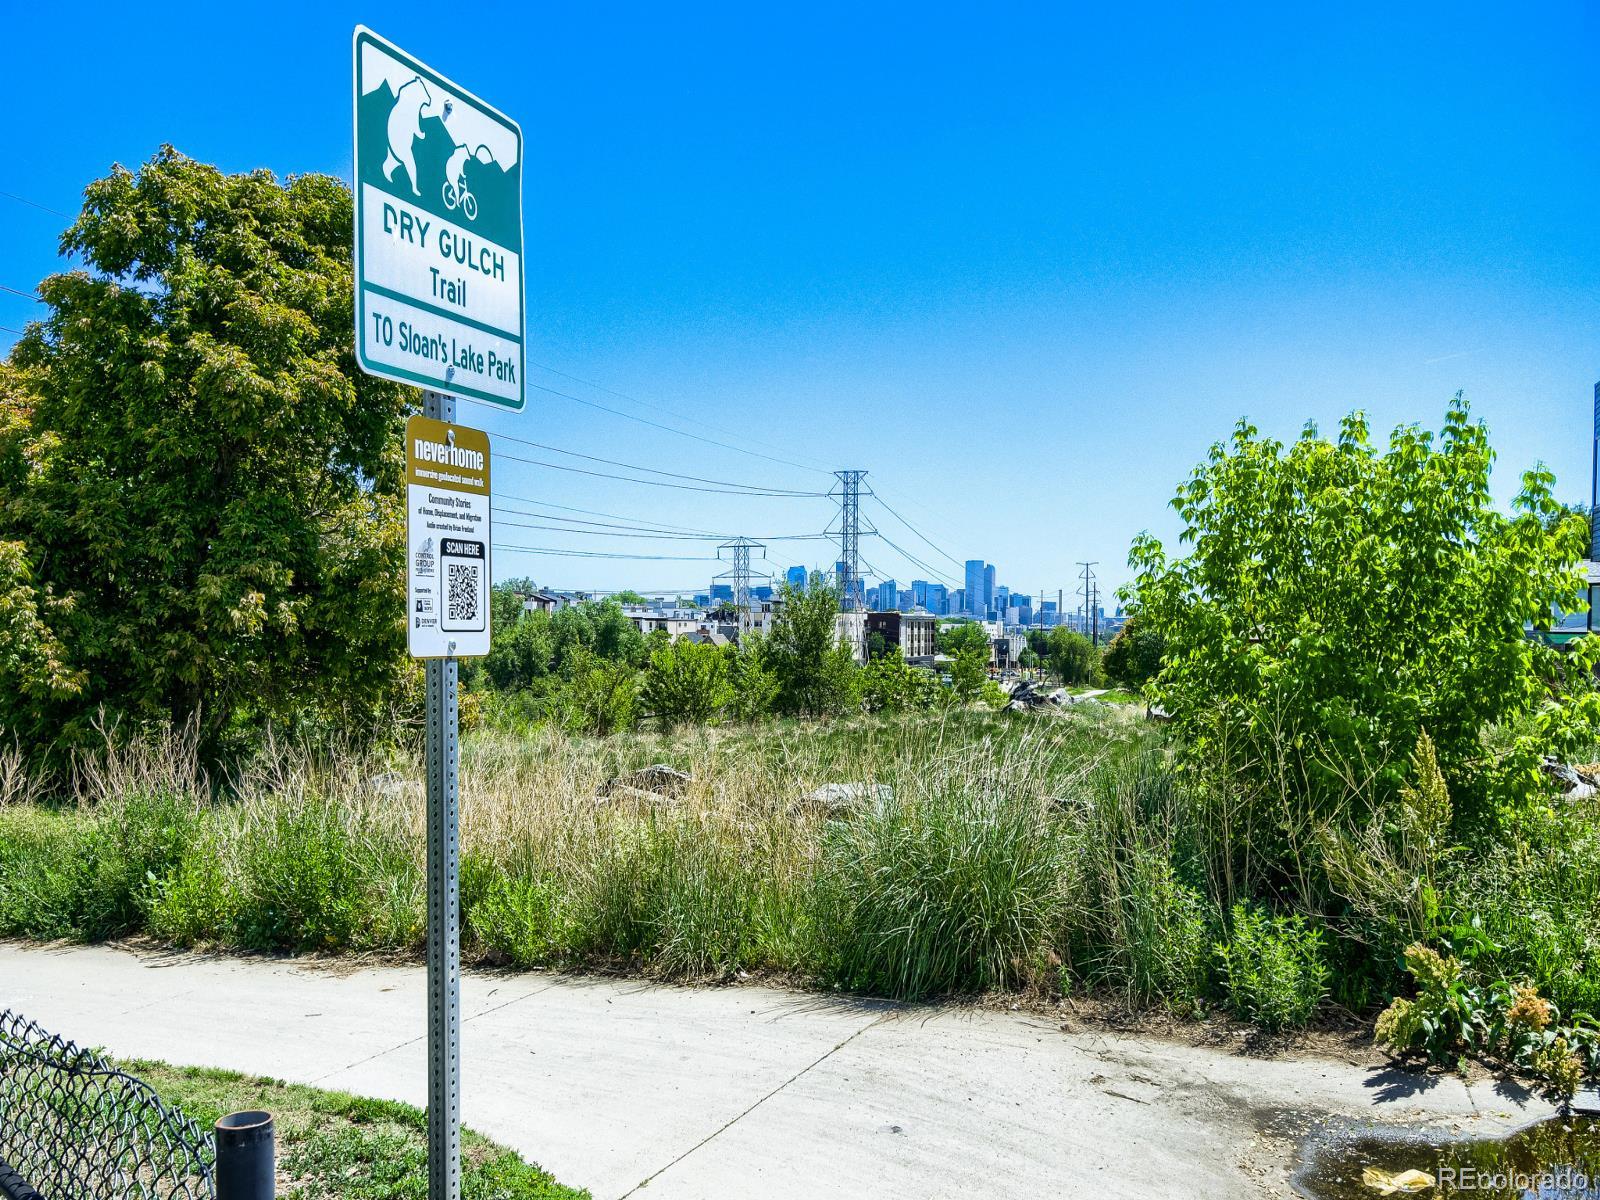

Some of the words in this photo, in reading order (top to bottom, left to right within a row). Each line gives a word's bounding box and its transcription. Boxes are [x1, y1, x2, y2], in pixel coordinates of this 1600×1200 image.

[383, 201, 431, 249] DRY
[438, 229, 505, 282] GULCH
[429, 266, 467, 308] Trail
[372, 311, 393, 347] TO
[398, 321, 448, 364] Sloan's
[452, 338, 484, 375] Lake
[488, 350, 516, 385] Park
[414, 438, 484, 471] neverhome
[428, 493, 455, 508] Community
[455, 497, 472, 509] Stories
[415, 559, 435, 568] GROUP
[446, 541, 463, 554] SCAN
[464, 543, 480, 556] HERE
